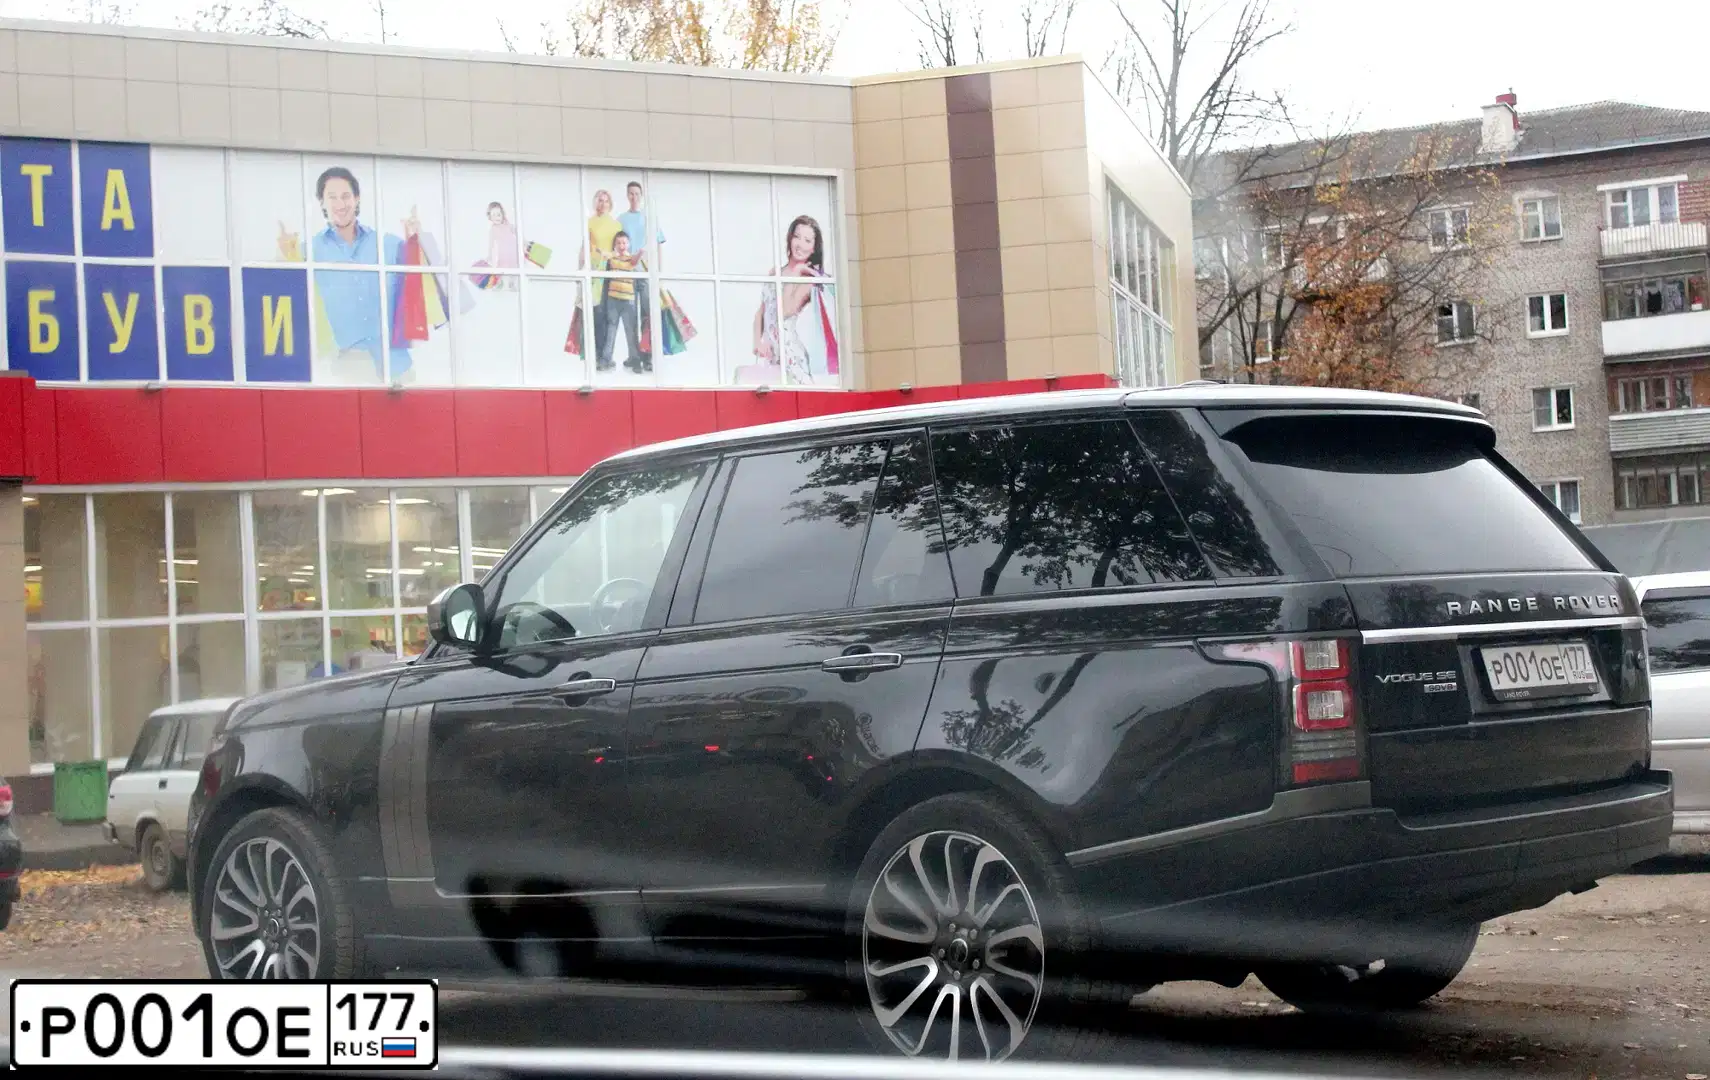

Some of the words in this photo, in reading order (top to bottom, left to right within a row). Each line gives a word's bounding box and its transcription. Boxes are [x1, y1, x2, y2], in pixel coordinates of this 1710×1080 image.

[27, 289, 294, 356] БУВИ
[1446, 597, 1540, 616] RANGE
[1553, 595, 1619, 610] ROVER
[1563, 646, 1588, 670] 177
[1375, 672, 1433, 683] VOGUE
[1436, 671, 1456, 680] SE
[1572, 670, 1586, 680] RUS
